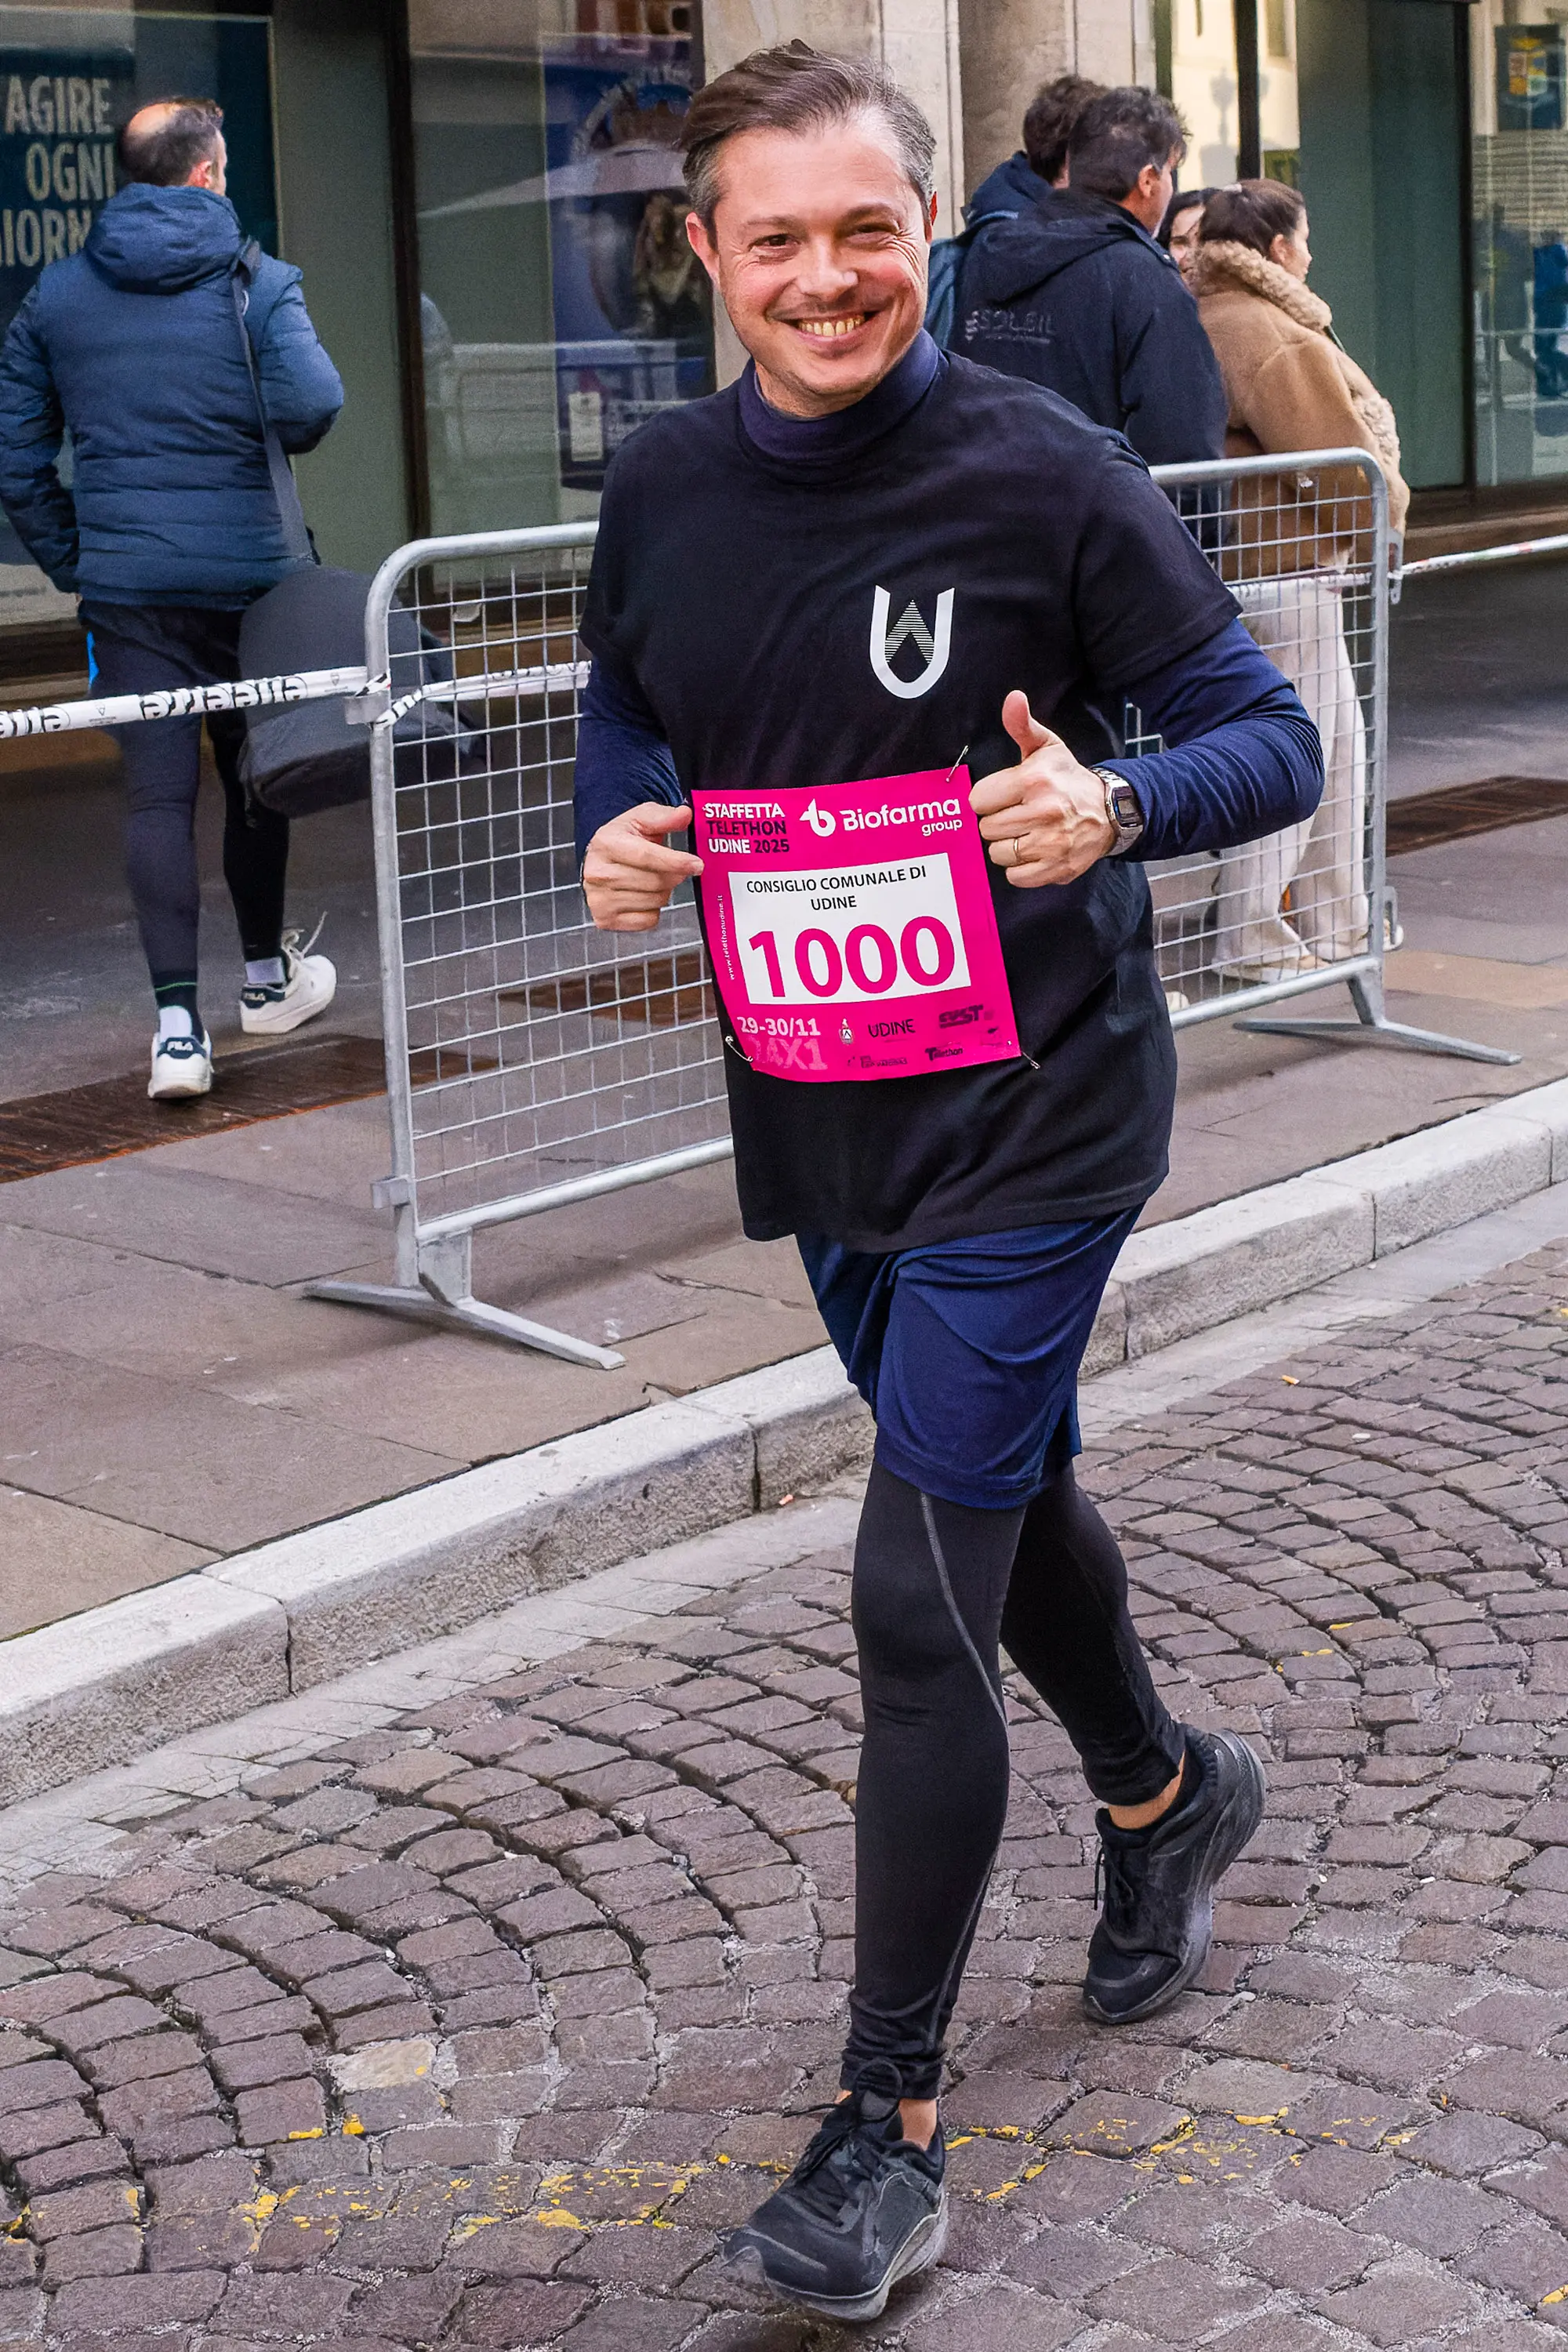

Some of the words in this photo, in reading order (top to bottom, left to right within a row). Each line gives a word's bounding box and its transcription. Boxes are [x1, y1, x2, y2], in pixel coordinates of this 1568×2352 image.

[5, 75, 114, 134] AGIRE
[26, 142, 115, 201] OGNI
[0, 208, 92, 267] IORN
[704, 803, 786, 818] STAFFETTA
[840, 798, 961, 831] Biofarma
[706, 820, 786, 836] TELETHON
[921, 818, 963, 837] group
[708, 838, 751, 854] UDINE
[753, 839, 790, 853] 2025
[746, 878, 817, 894] CONSIGLIO
[820, 868, 907, 890] COMUNALE
[909, 865, 927, 880] DI
[810, 895, 858, 911] UDINE
[717, 895, 735, 981] www.telethonudine.it
[748, 916, 955, 998] 1000
[736, 1016, 822, 1038] 29-30/11
[867, 1018, 916, 1038] UDINE
